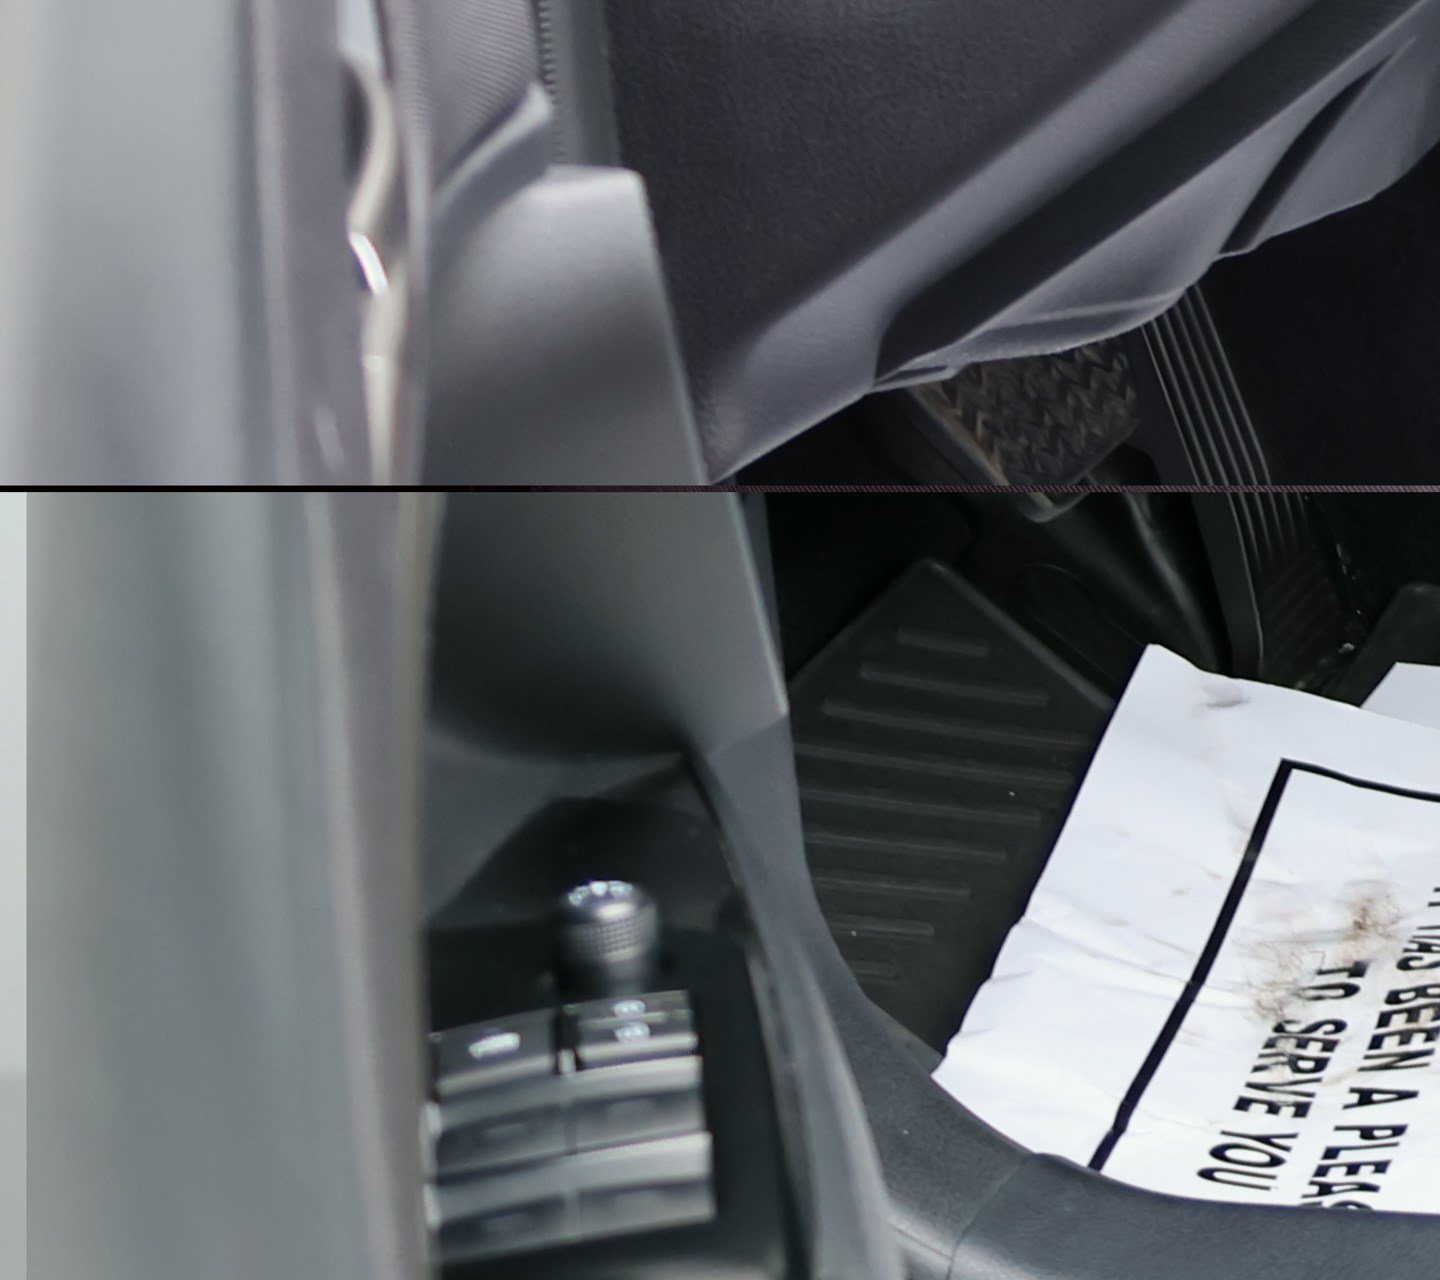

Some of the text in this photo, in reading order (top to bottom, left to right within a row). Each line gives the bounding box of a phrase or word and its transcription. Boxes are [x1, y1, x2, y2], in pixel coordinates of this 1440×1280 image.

[1196, 959, 1371, 1191] TO SERVE YOU
[1342, 1087, 1420, 1110] A
